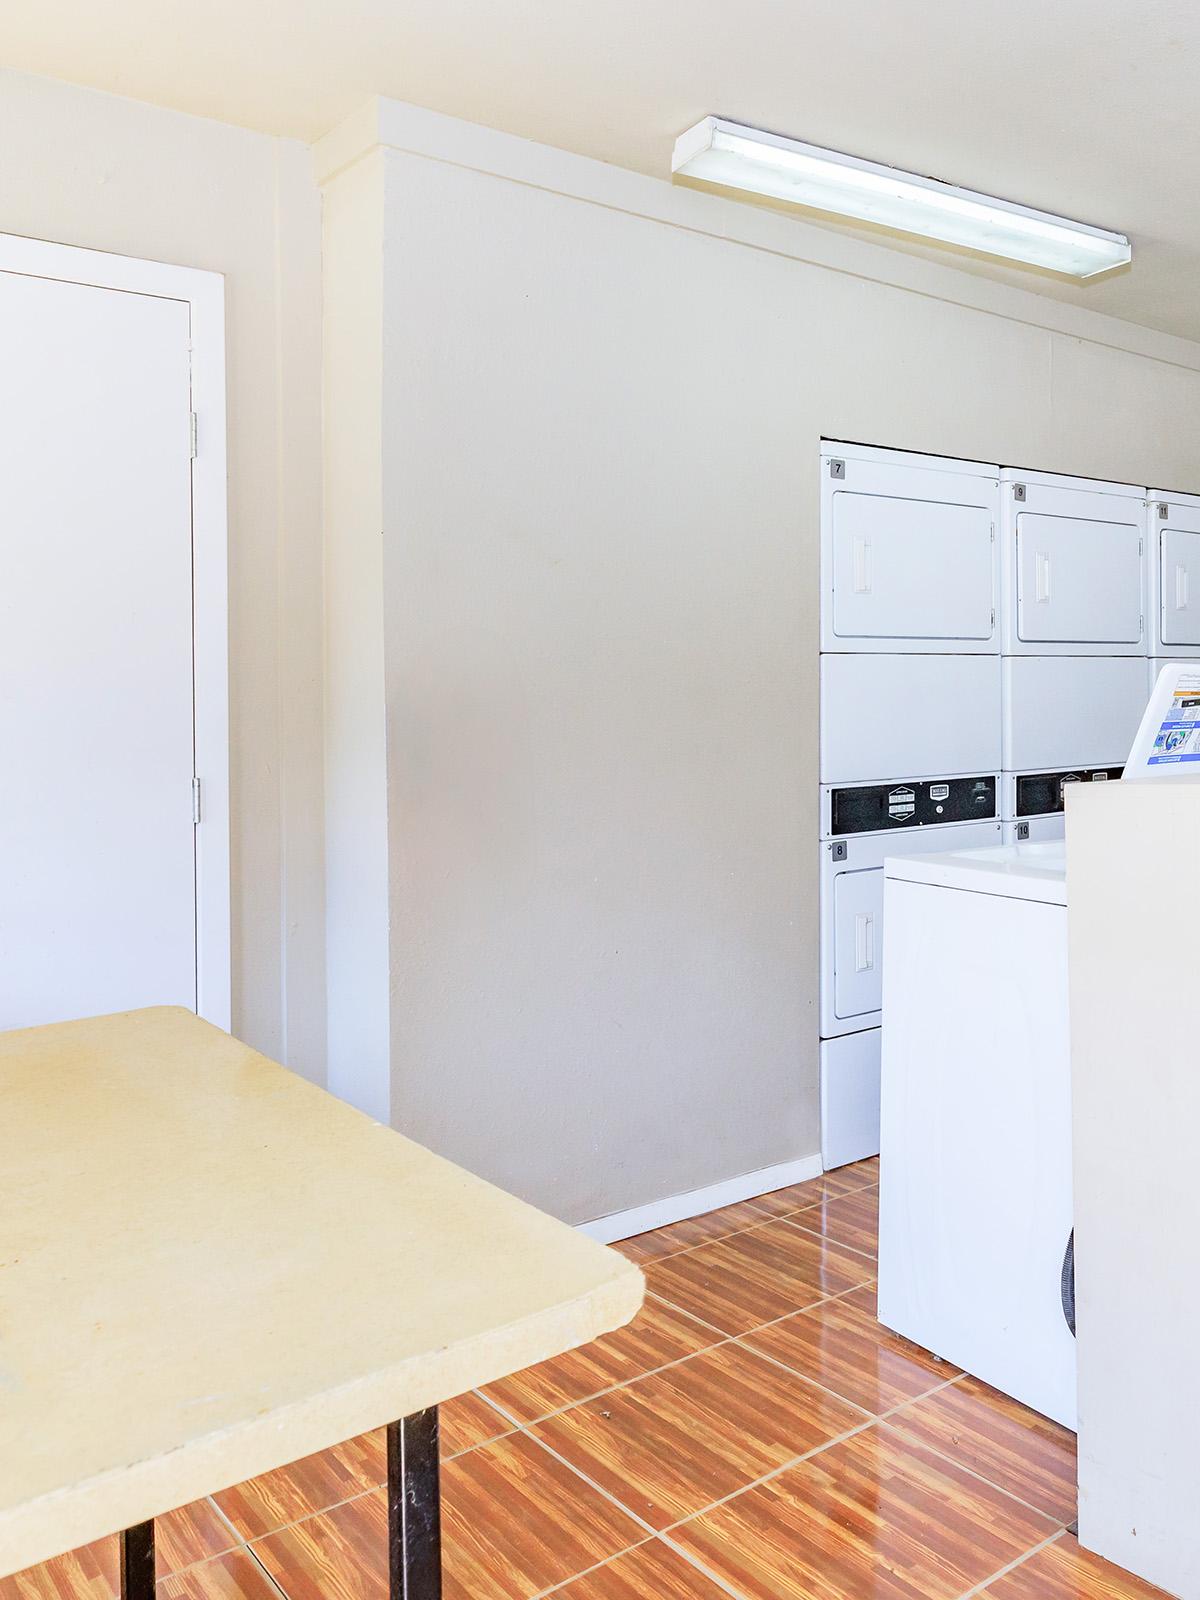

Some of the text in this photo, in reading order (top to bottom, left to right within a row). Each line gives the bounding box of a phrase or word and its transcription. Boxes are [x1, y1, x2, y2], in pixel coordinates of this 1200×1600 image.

[836, 464, 841, 473] 7
[1018, 488, 1023, 497] 9
[1020, 825, 1028, 835] 10
[837, 845, 843, 855] 8
